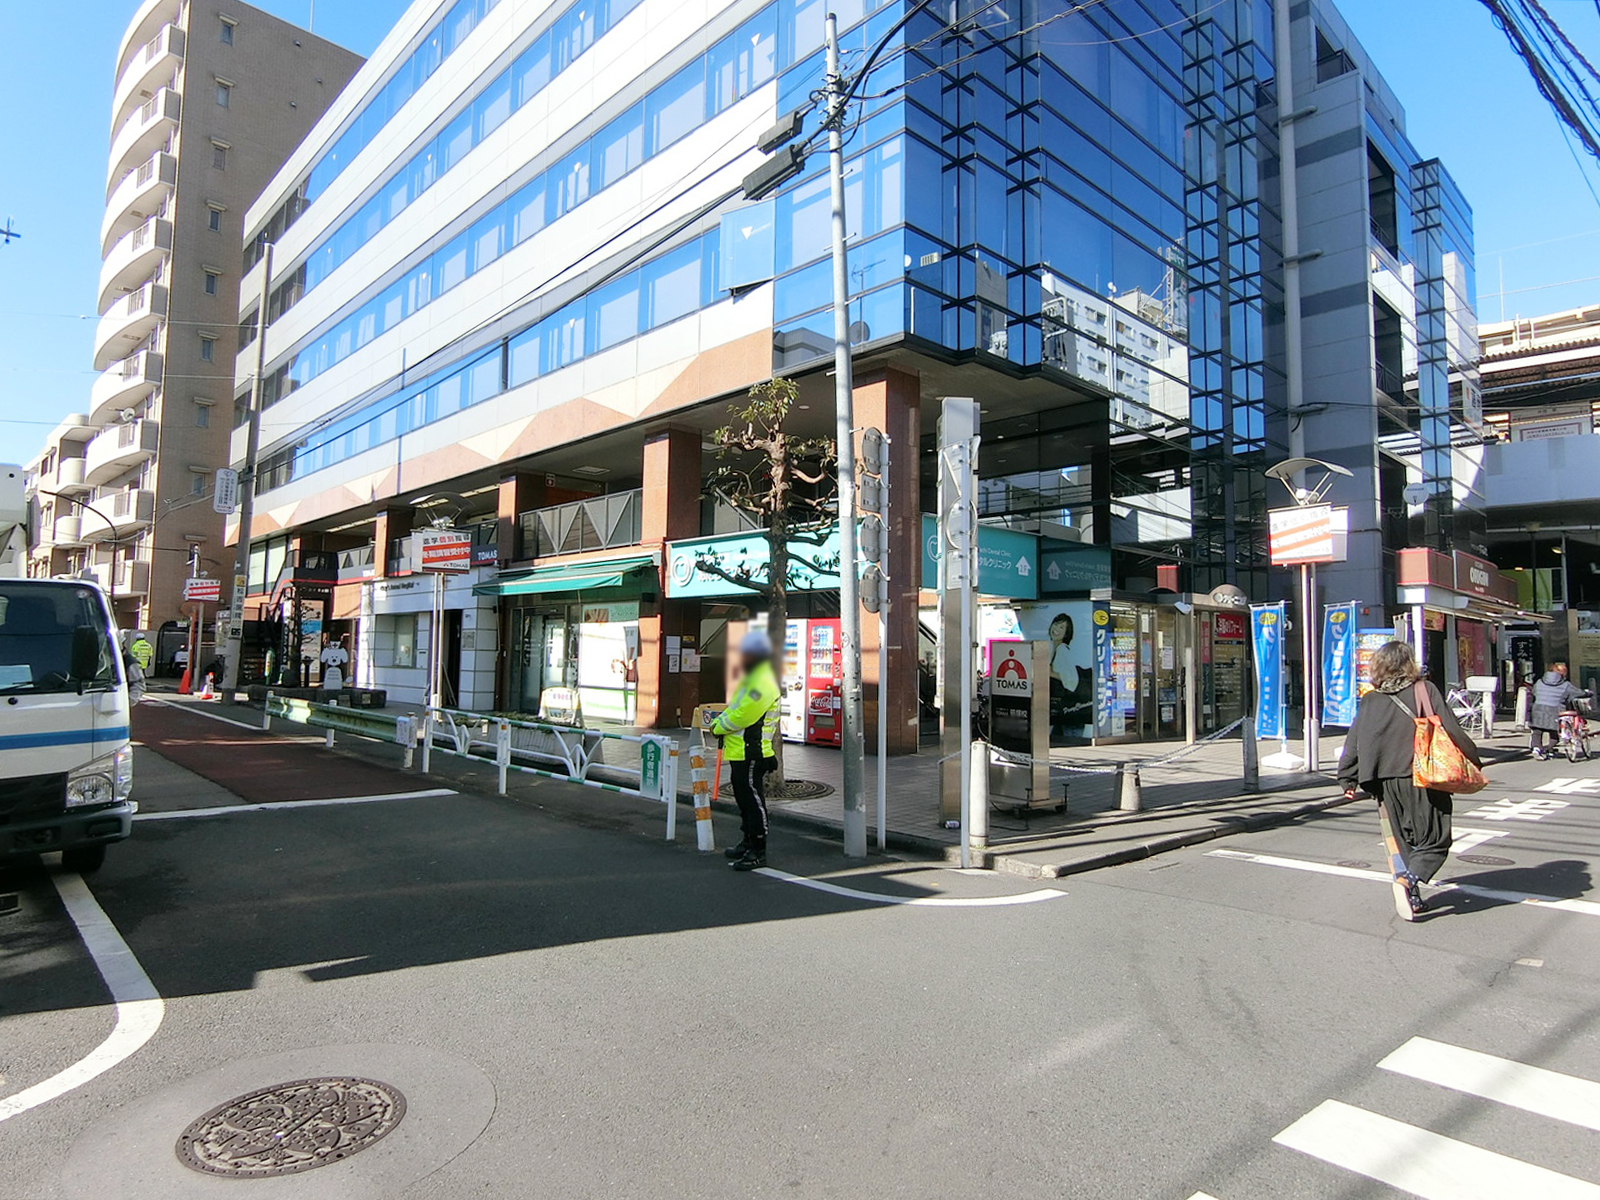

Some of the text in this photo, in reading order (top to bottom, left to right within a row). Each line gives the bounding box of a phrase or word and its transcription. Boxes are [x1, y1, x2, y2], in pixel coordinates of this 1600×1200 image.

[423, 534, 470, 545] 進学個別指導
[477, 549, 498, 561] TOMAS
[1096, 629, 1108, 727] クリーニング
[996, 679, 1028, 691] TOMAS
